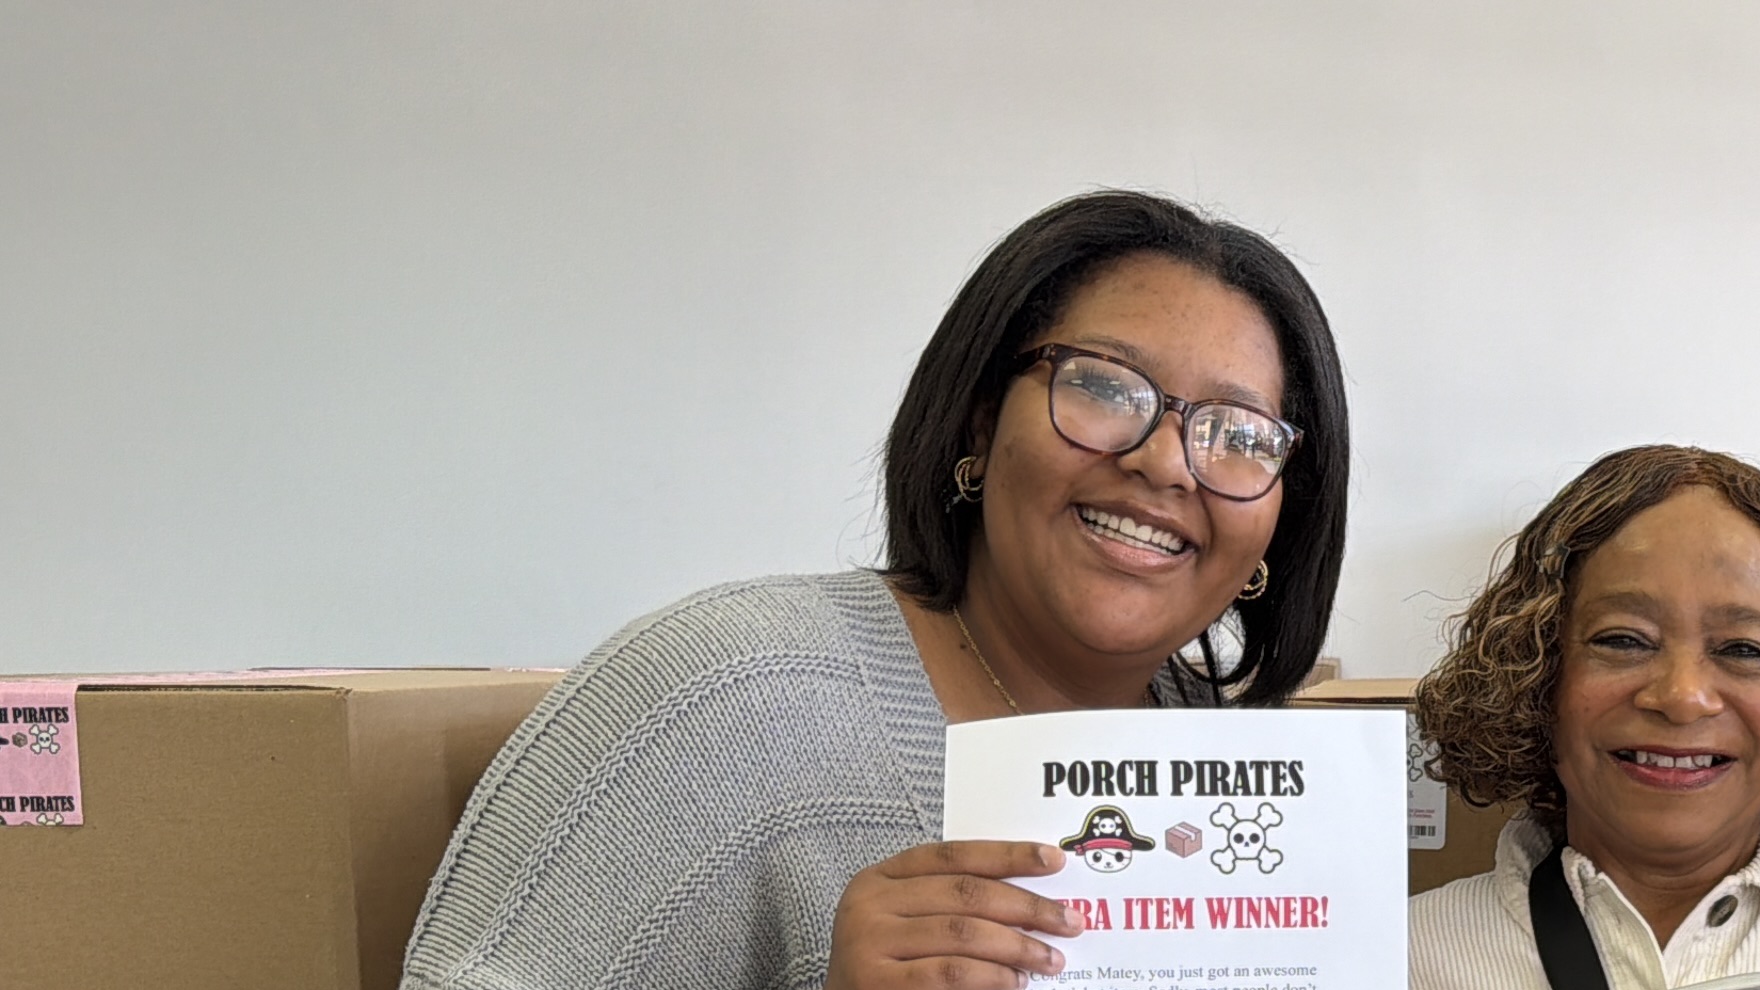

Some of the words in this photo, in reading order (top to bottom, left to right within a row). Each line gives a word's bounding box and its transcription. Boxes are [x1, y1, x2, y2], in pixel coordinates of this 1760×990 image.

[12, 707, 69, 723] PIRATES
[1043, 760, 1159, 797] PORCH
[1170, 760, 1305, 797] PIRATES
[19, 796, 75, 812] PIRATES
[1124, 898, 1195, 930] ITEM
[1205, 896, 1329, 929] WINNER!
[1097, 967, 1144, 982] Matey,
[1149, 969, 1174, 981] you
[1177, 965, 1203, 981] just
[1208, 967, 1229, 981] got
[1234, 967, 1249, 977] an
[1254, 966, 1317, 977] awesome
